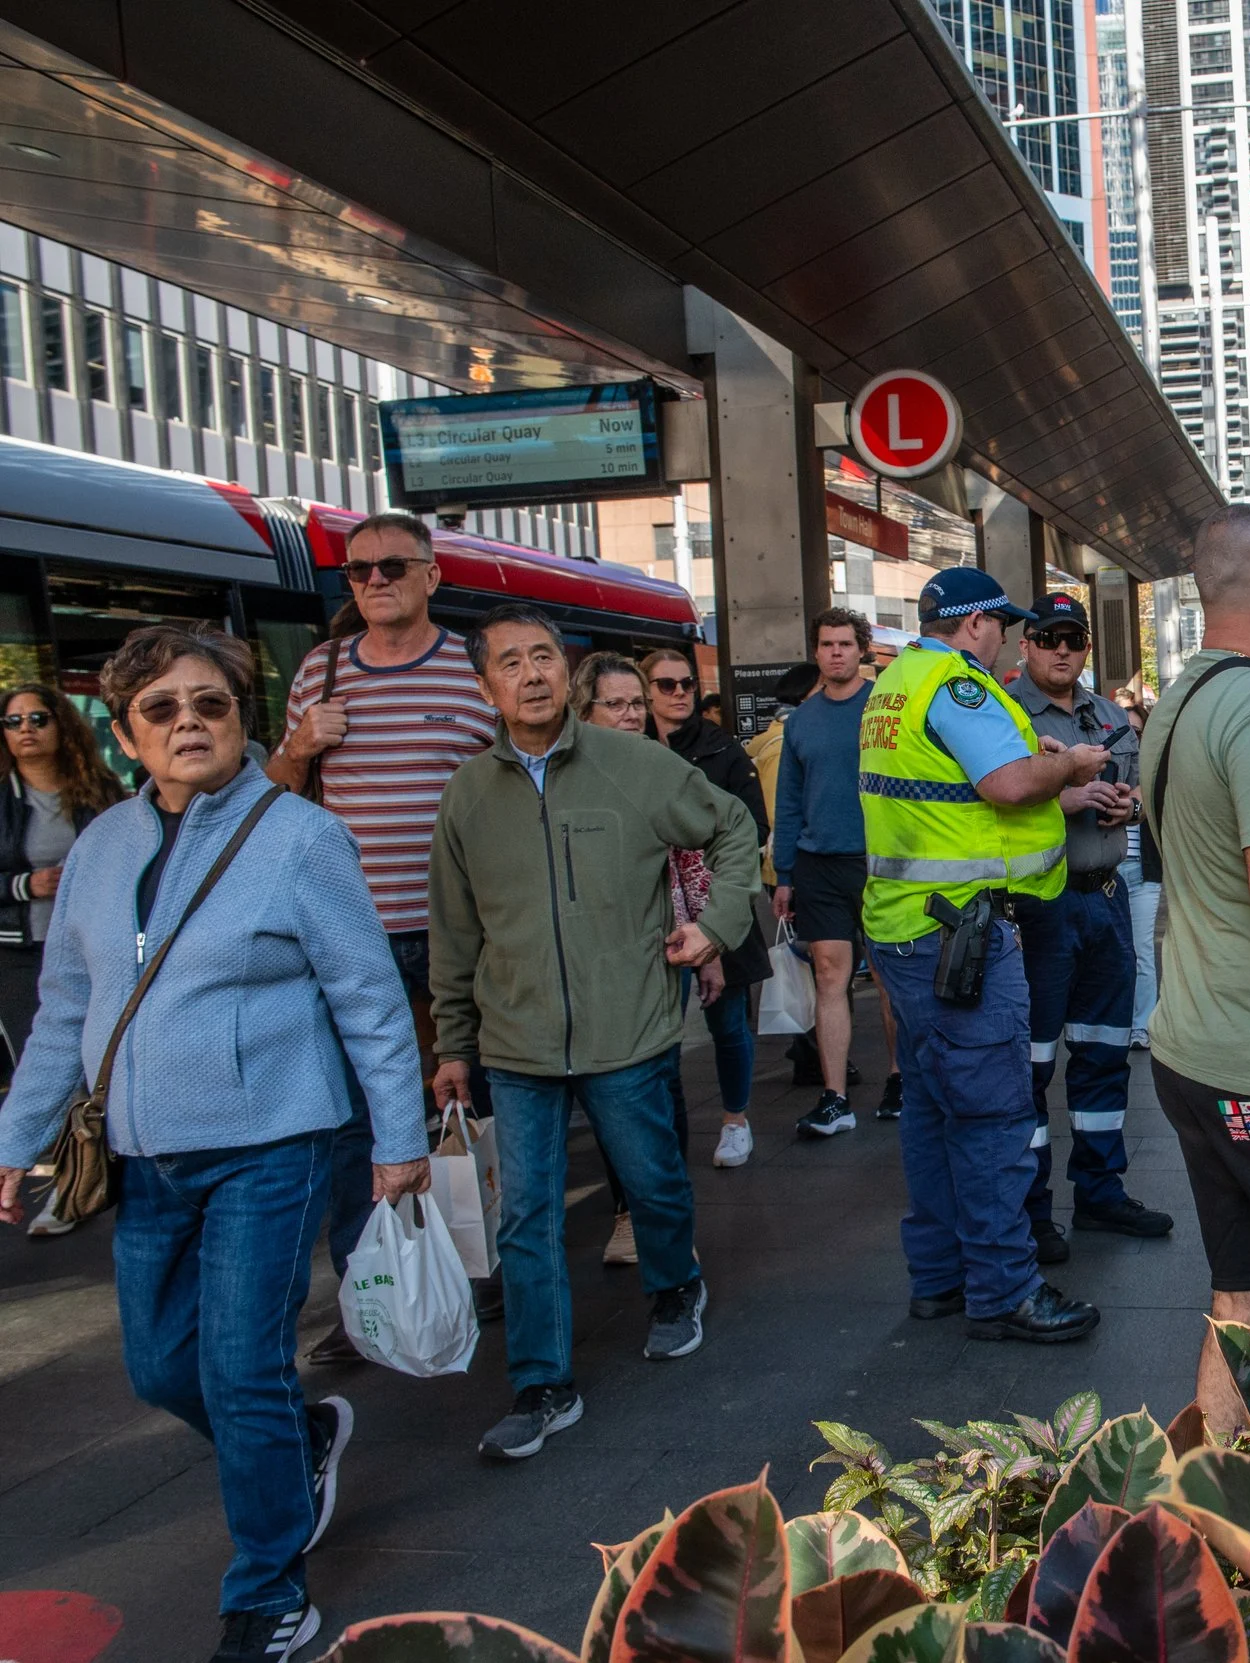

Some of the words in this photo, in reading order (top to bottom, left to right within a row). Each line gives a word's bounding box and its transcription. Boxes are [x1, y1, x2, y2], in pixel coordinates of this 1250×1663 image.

[437, 427, 496, 446] Circular
[502, 424, 541, 443] Quay
[600, 417, 634, 434] Now
[888, 394, 923, 450] L
[440, 453, 481, 467] Circular
[483, 451, 511, 465] Quay
[605, 443, 613, 454] 5
[615, 441, 636, 453] min
[441, 472, 483, 486] Circular
[486, 470, 513, 483] Quay
[601, 462, 614, 474] 10
[617, 460, 638, 472] min
[838, 505, 858, 534] Town
[858, 513, 873, 538] Hall
[1054, 603, 1071, 611] NSW
[734, 669, 760, 678] Please
[373, 1274, 394, 1287] BAG
